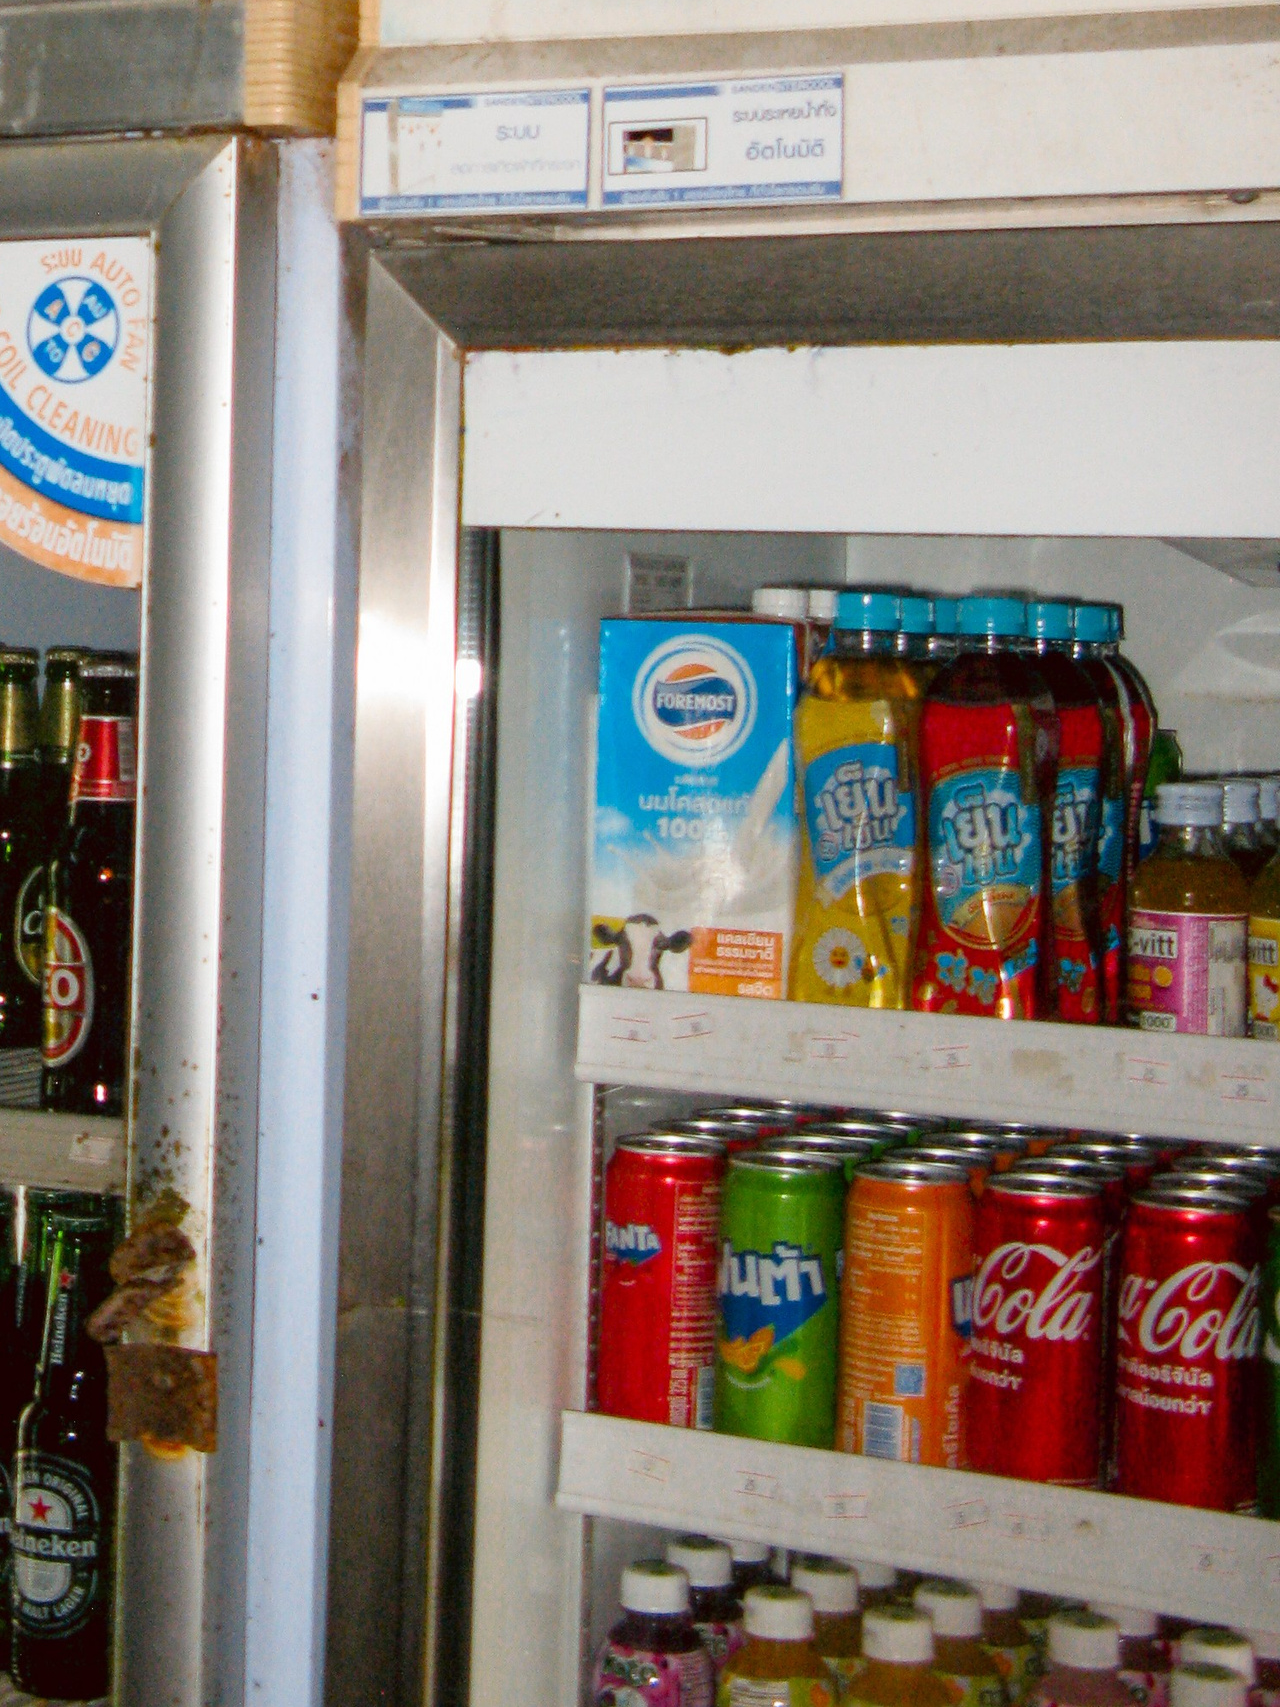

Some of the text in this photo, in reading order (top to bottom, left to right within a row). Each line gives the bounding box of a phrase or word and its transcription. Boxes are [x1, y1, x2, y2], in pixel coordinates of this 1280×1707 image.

[90, 251, 142, 308] AUTO
[25, 384, 139, 457] CLEANING
[655, 692, 735, 712] FOREMOST
[1131, 933, 1175, 956] -vitt
[49, 1292, 70, 1366] Heineken
[10, 1527, 97, 1558] eineken
